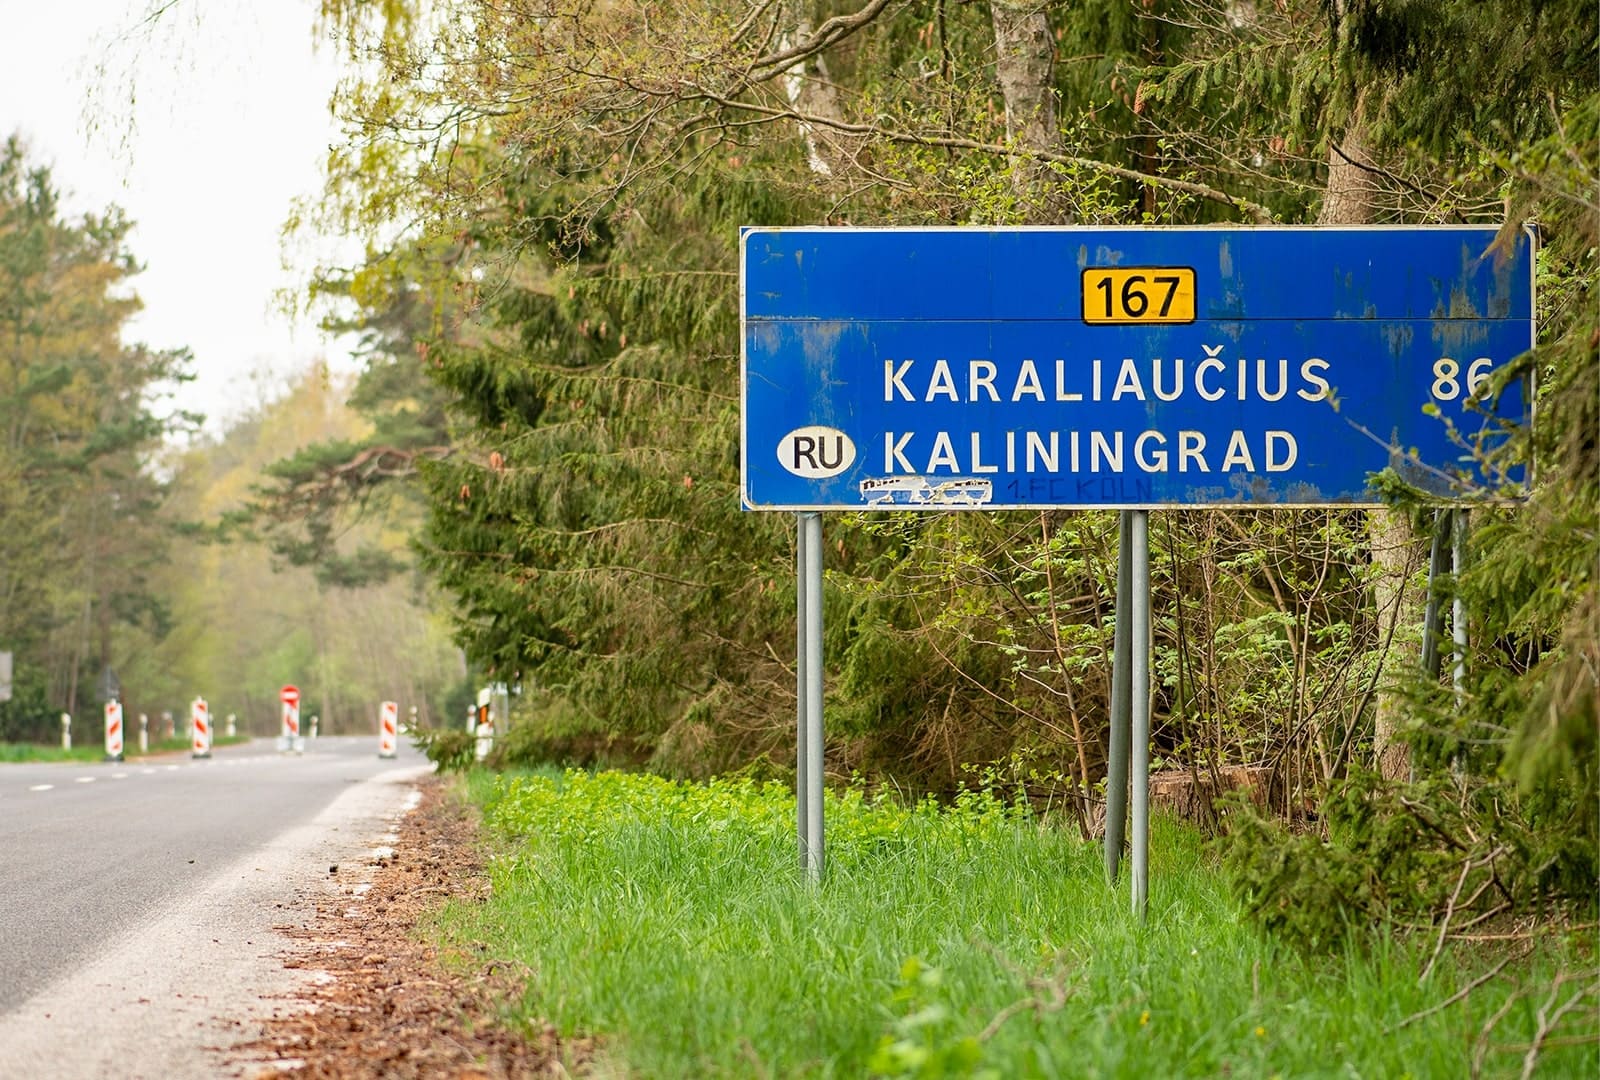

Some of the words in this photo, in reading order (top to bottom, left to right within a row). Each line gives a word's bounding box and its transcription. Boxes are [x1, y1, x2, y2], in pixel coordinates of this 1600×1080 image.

[1096, 275, 1181, 318] 167
[884, 344, 1331, 402] KARALIAUČIUS
[1431, 357, 1494, 401] 86
[793, 436, 843, 470] RU
[884, 430, 1299, 473] KALININGRAD
